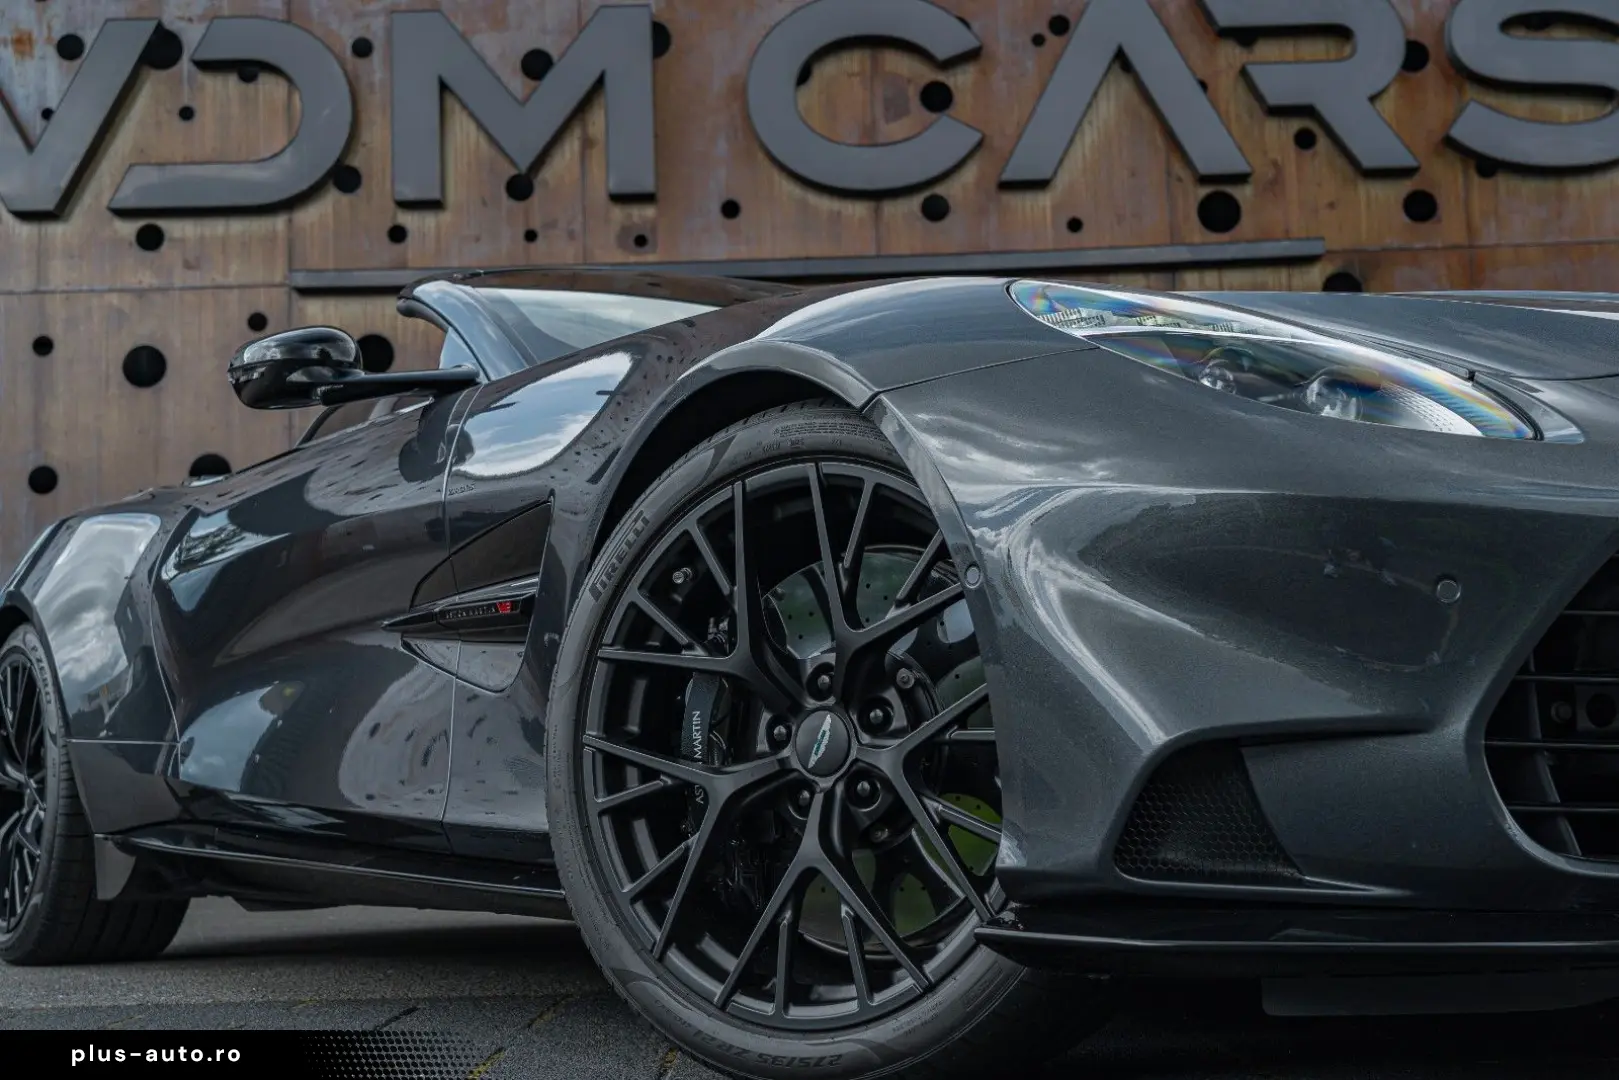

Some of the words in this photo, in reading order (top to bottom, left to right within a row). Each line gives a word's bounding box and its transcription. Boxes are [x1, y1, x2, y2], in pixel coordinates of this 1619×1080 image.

[0, 5, 657, 215] VDM
[746, 0, 1619, 196] CARS
[588, 509, 650, 603] PIRELLI
[692, 710, 703, 759] MARTIN
